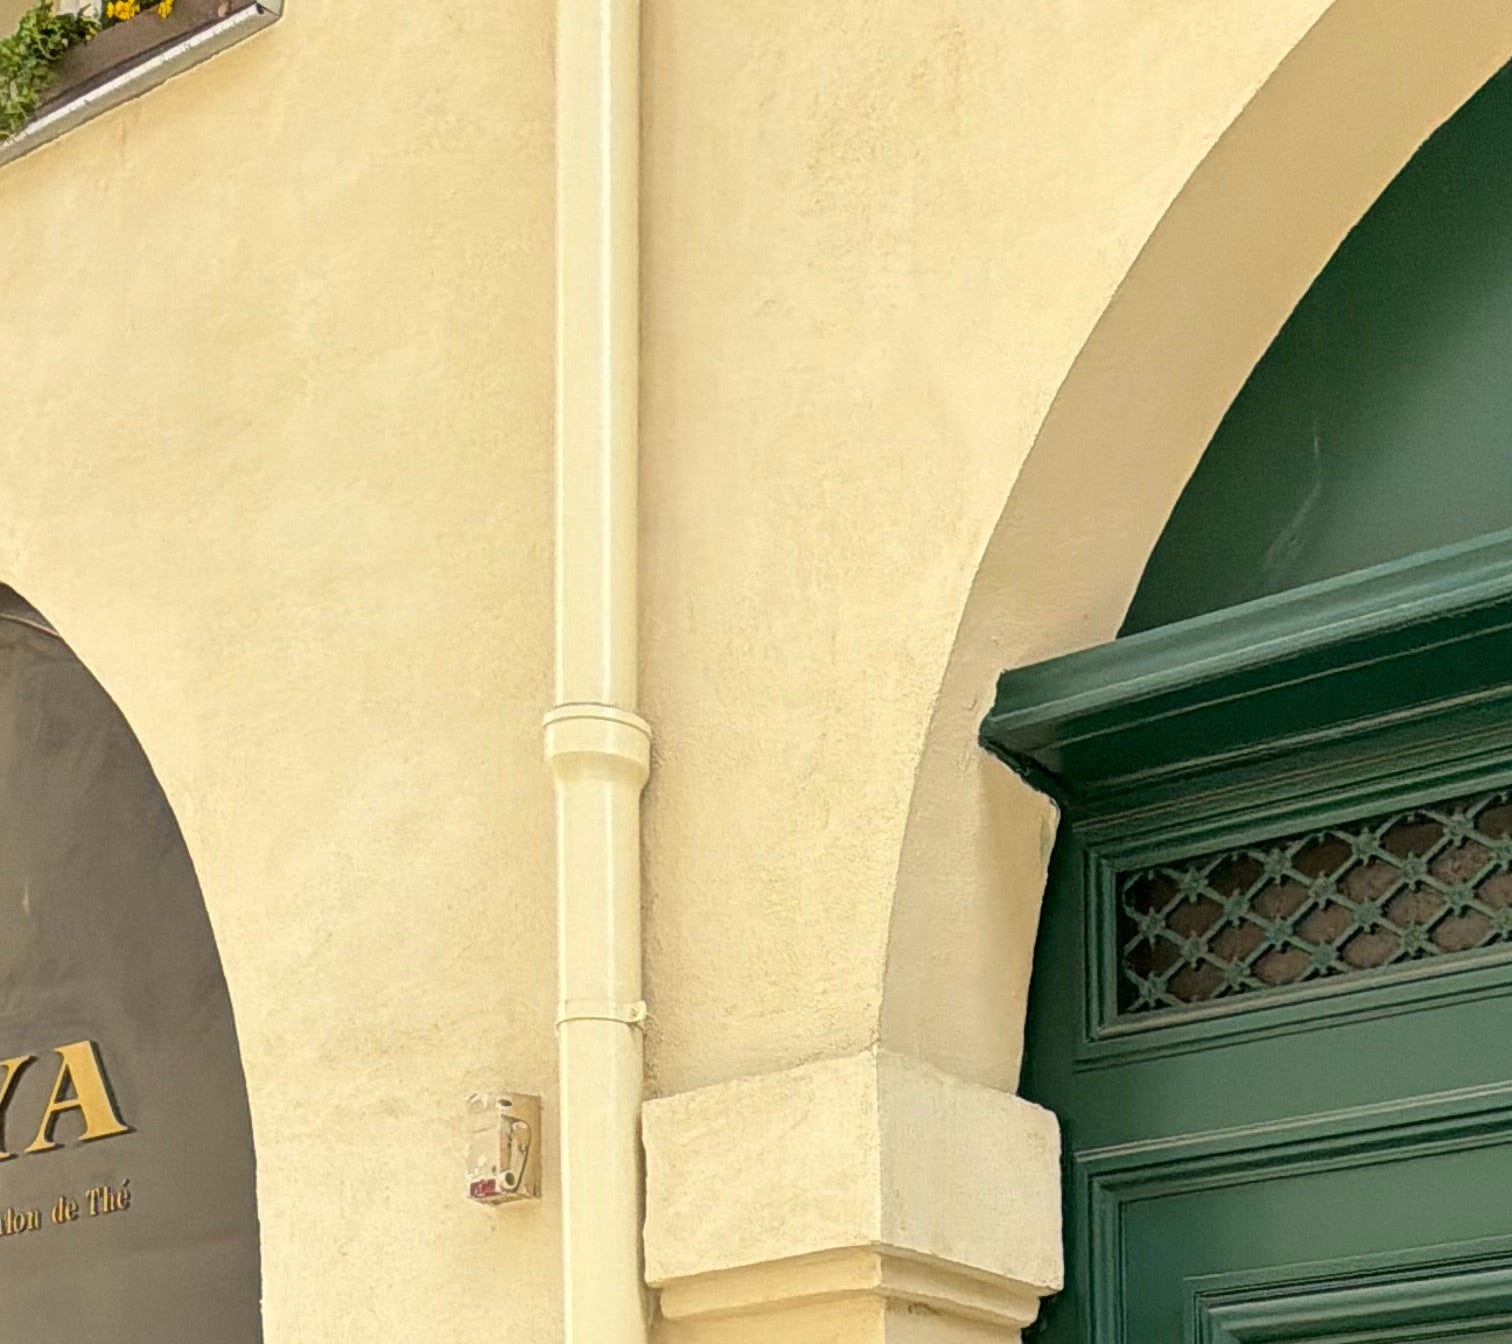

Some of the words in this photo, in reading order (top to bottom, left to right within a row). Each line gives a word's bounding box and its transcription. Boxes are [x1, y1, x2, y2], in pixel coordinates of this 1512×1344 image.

[0, 1207, 40, 1236] lon
[52, 1196, 78, 1225] de
[86, 1178, 130, 1217] Thé
